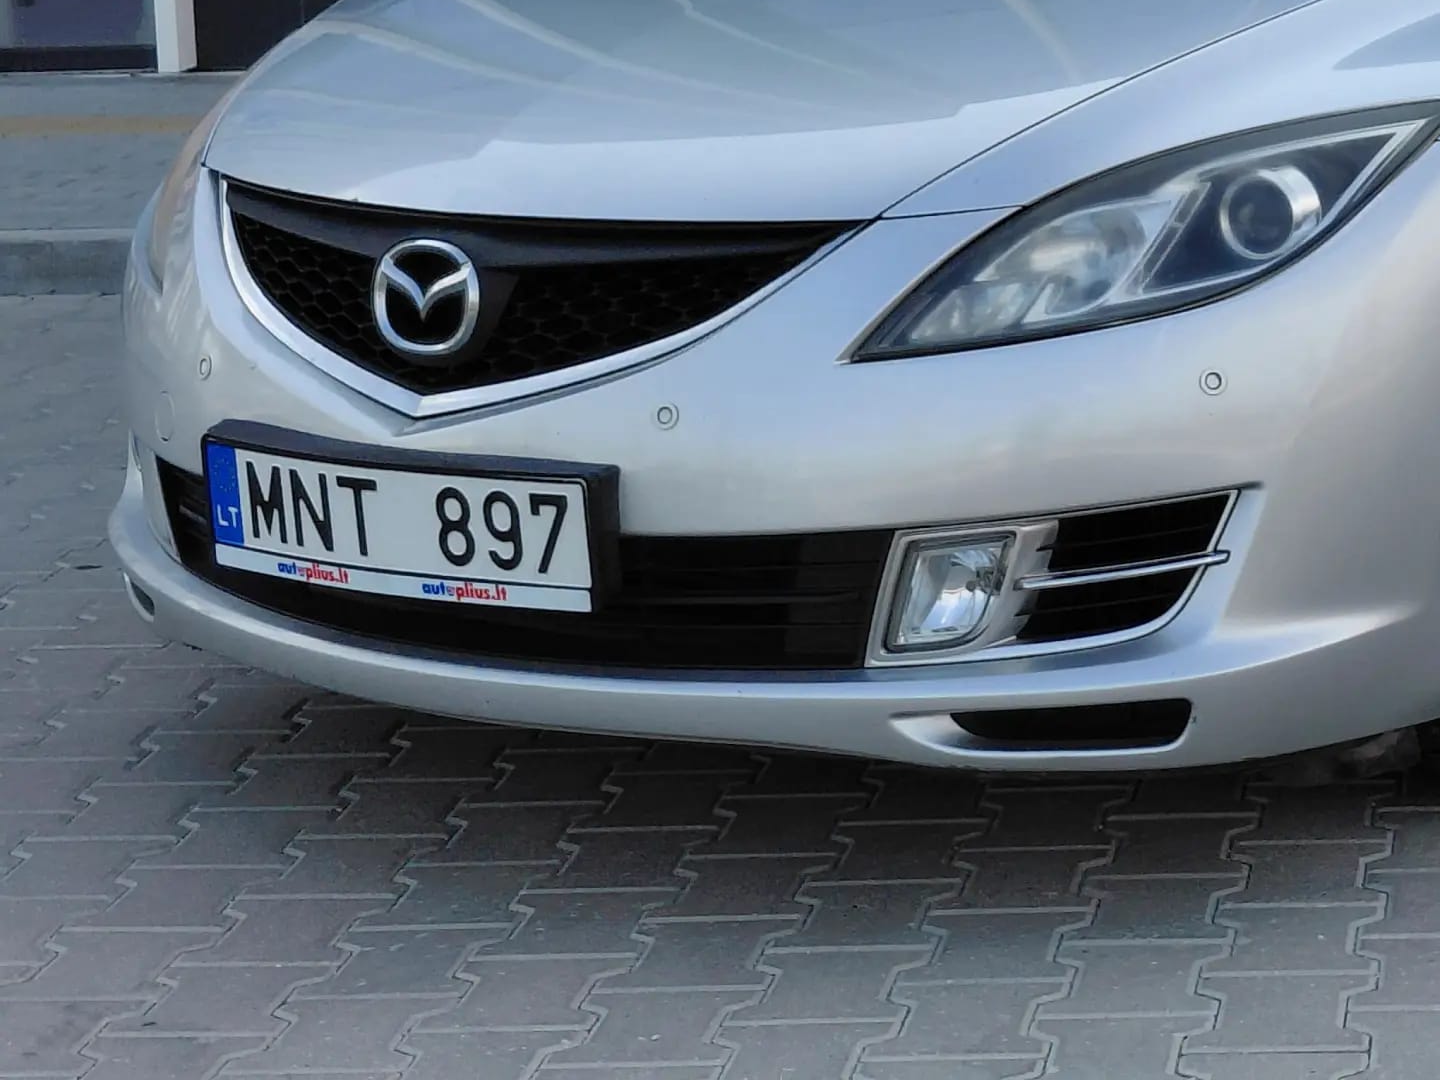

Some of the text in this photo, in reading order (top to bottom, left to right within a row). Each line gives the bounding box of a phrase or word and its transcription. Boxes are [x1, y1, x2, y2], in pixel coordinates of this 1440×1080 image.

[216, 503, 239, 528] LT
[246, 461, 568, 574] MNT 897
